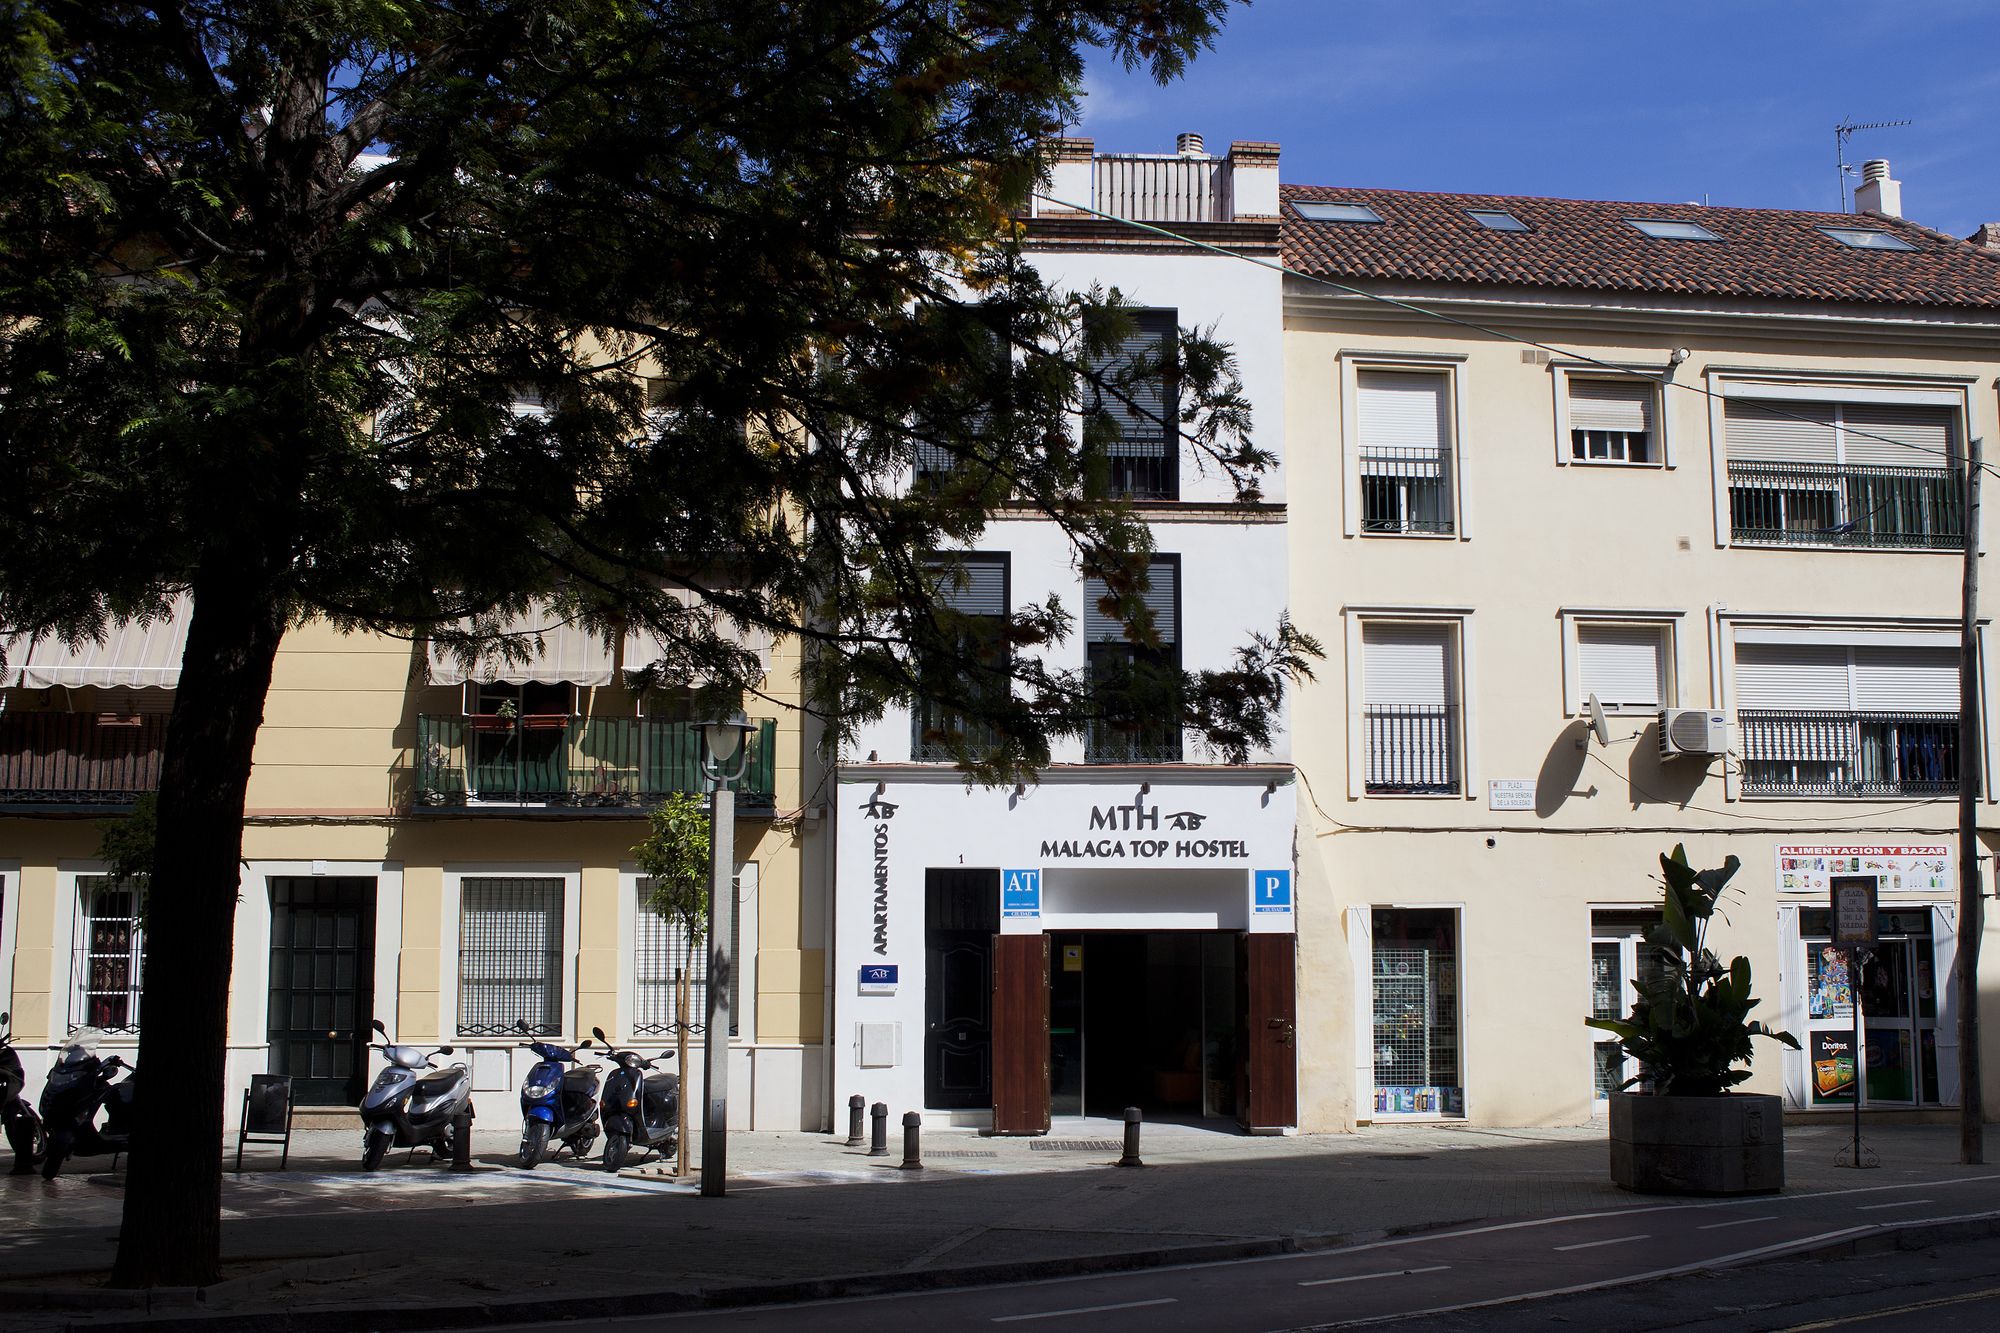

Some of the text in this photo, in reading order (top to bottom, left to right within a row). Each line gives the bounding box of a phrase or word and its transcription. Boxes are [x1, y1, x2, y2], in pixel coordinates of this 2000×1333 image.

[860, 802, 898, 820] AB
[1088, 805, 1206, 831] MTH AB
[1040, 839, 1249, 858] MALAGA TOP HOSTEL
[1781, 847, 1946, 855] ALIMENTACION Y BAZAR
[959, 854, 963, 864] 1
[873, 823, 888, 956] APARTAMENTOS
[1007, 872, 1036, 892] AT
[1265, 877, 1280, 898] P
[1822, 1042, 1848, 1050] Doritos
